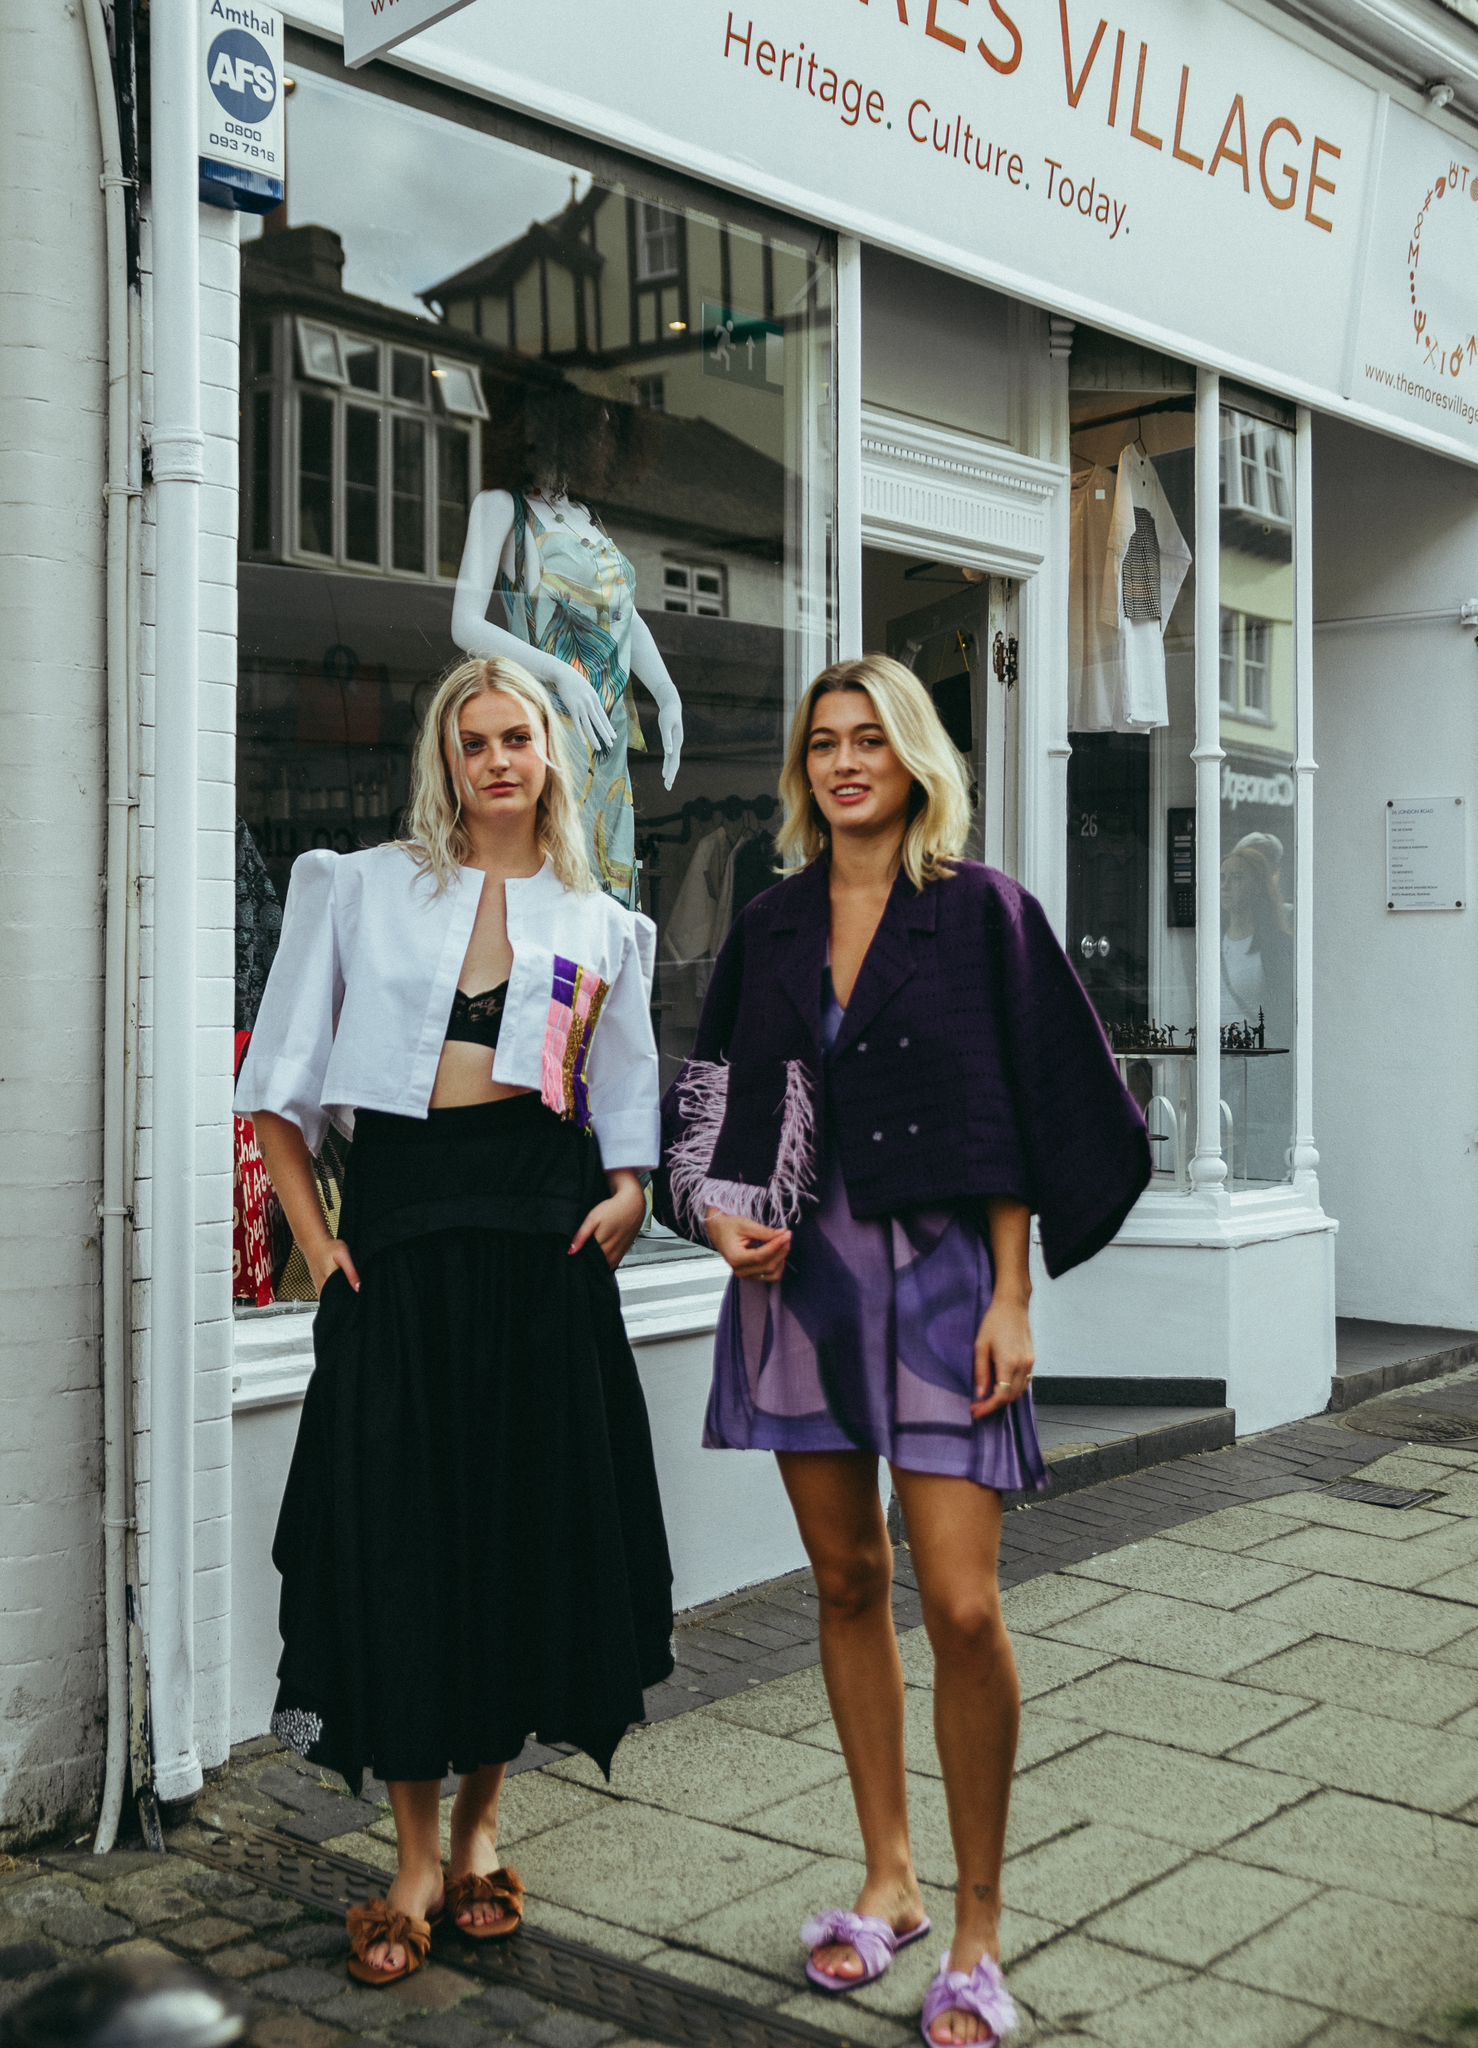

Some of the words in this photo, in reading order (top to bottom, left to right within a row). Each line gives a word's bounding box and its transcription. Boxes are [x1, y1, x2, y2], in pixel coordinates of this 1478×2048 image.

[211, 0, 275, 38] Amthal
[210, 51, 275, 103] AFS
[224, 121, 262, 142] 0800
[723, 11, 892, 129] Heritage.
[907, 98, 1030, 191] Culture.
[1044, 157, 1130, 240] Today.
[1059, 0, 1341, 233] VILLAGE
[209, 133, 239, 151] 093
[243, 142, 275, 163] 7818
[1081, 813, 1098, 838] 26
